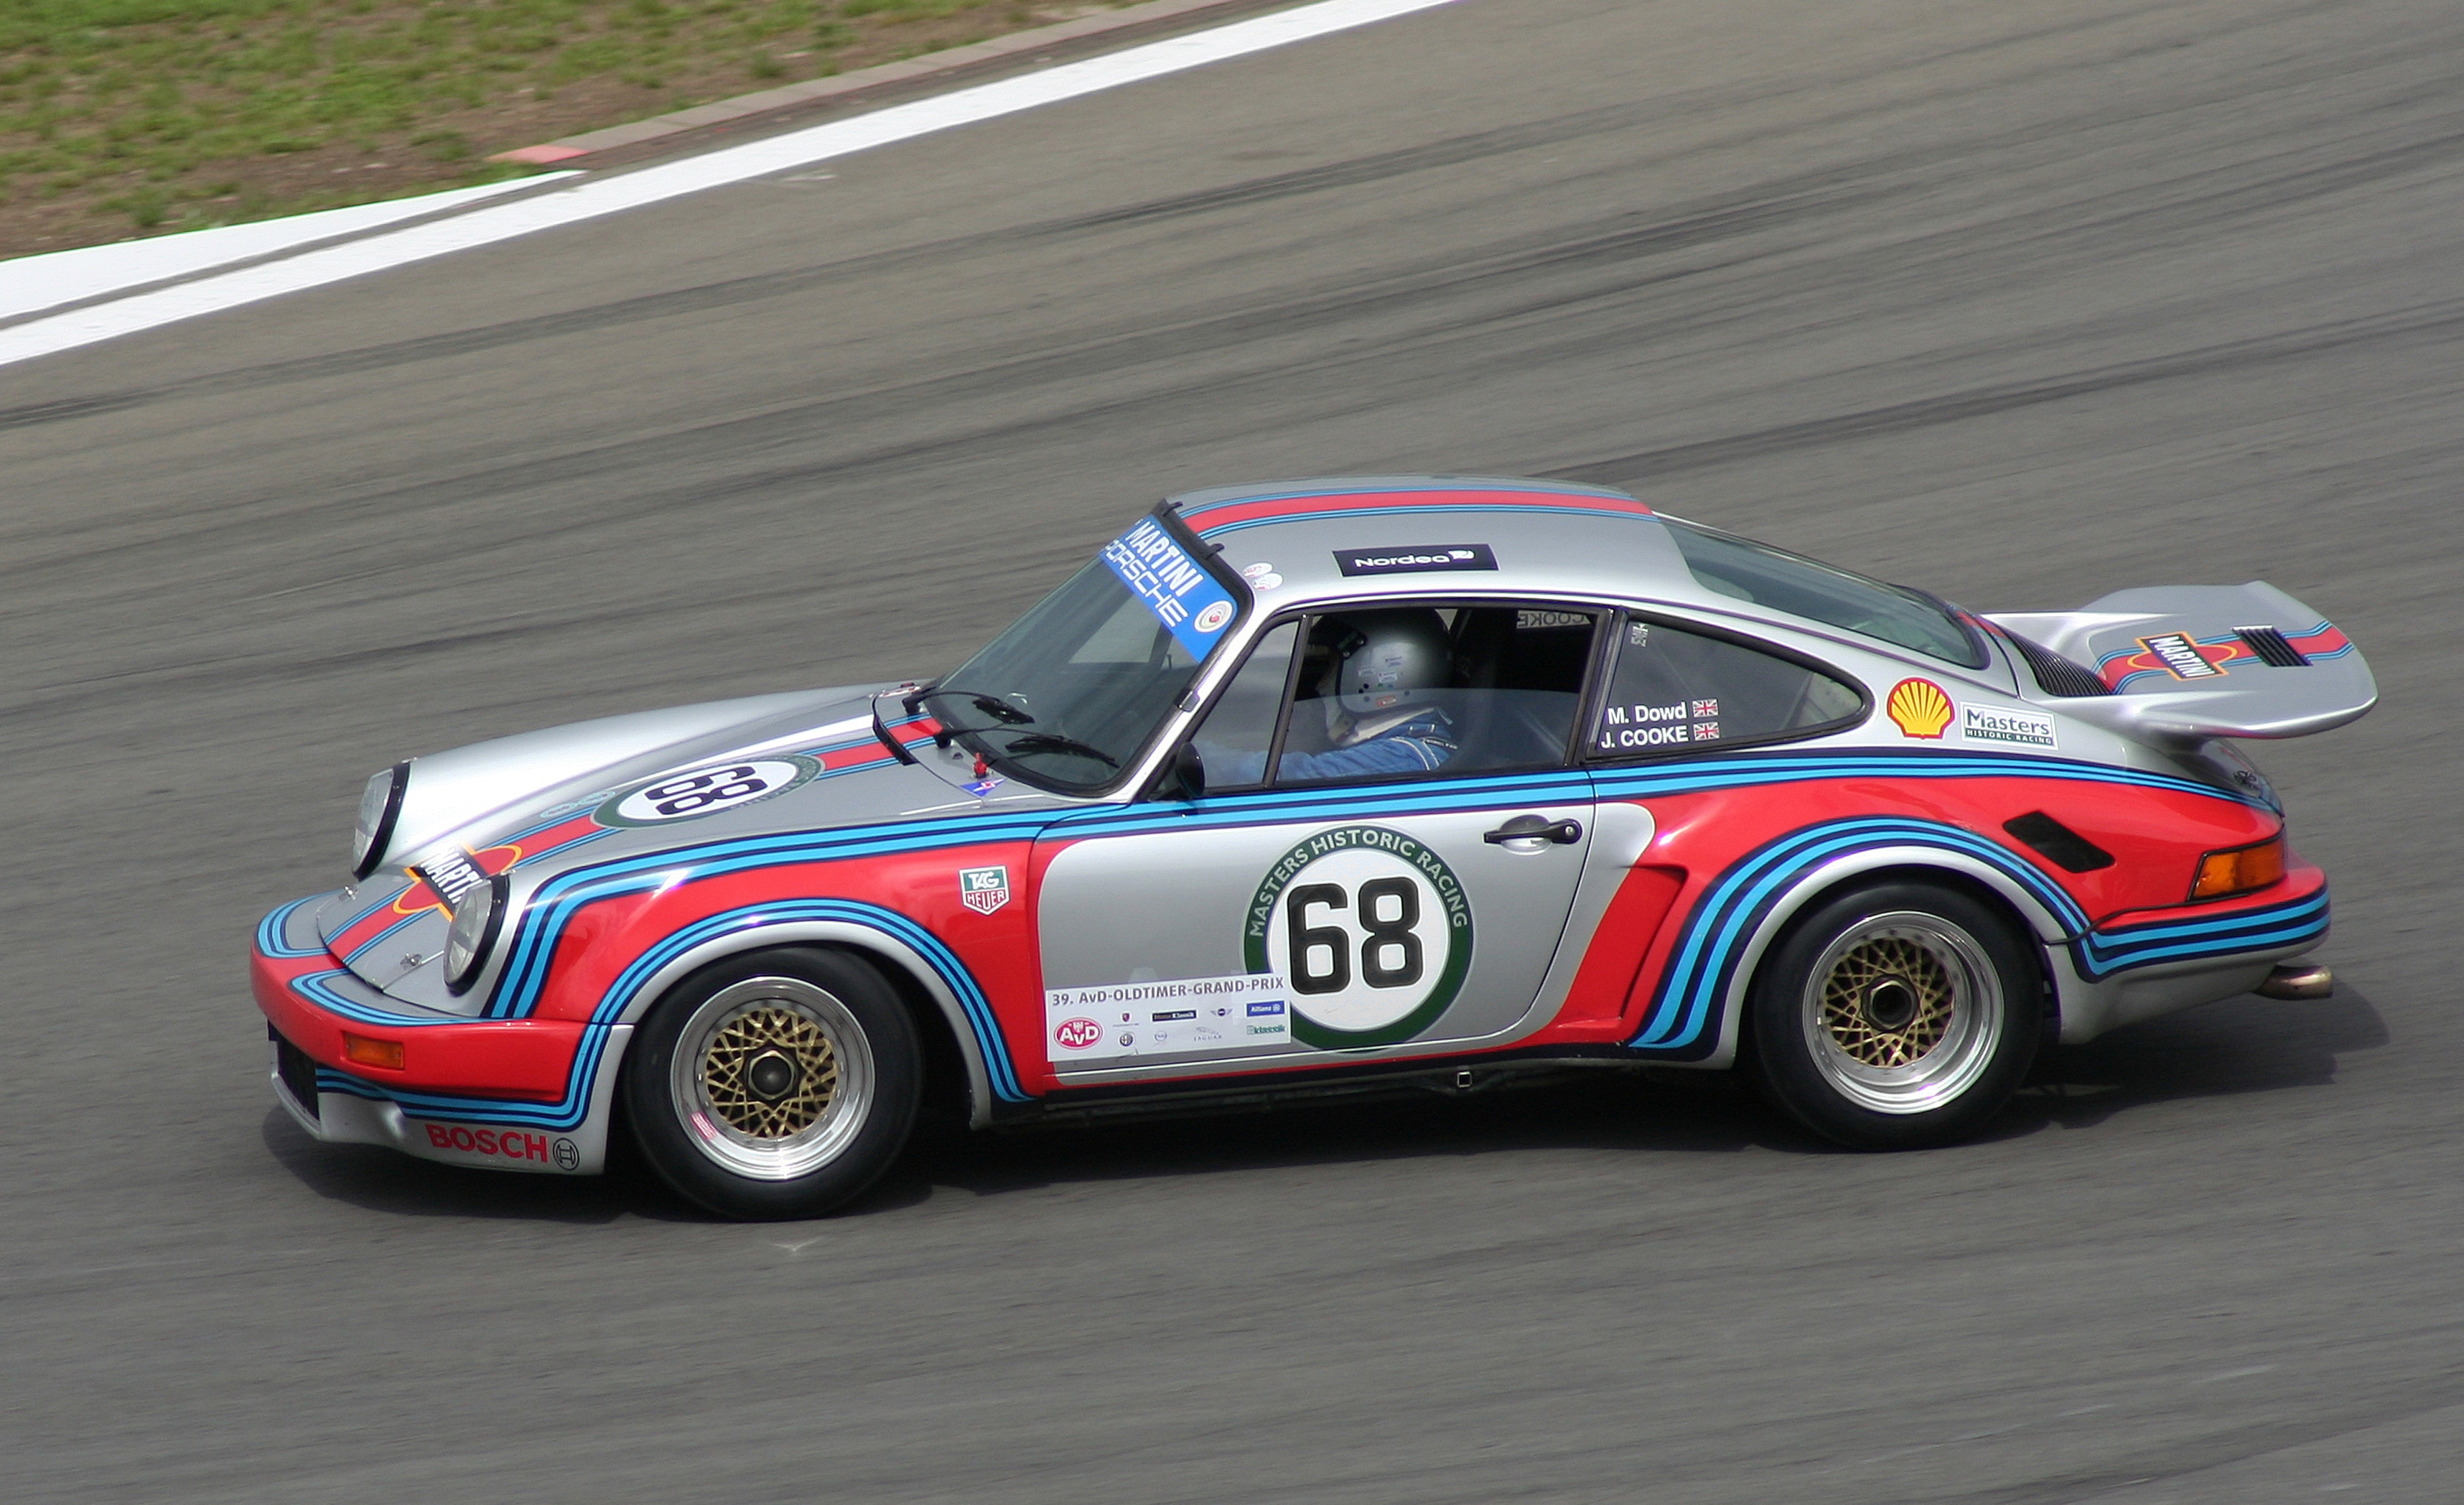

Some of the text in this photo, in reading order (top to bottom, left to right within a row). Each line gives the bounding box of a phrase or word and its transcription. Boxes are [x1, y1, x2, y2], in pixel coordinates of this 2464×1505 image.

[1125, 521, 1204, 597] MARTINI
[1354, 554, 1450, 567] Nordea
[2149, 635, 2216, 677] MARTINI
[1607, 702, 1687, 725] M. Dowd
[1966, 709, 2050, 735] Masters
[1600, 725, 1689, 748] J. COOKE
[1967, 730, 2052, 745] HISTORIC RACING
[645, 765, 768, 816] 68
[420, 847, 483, 904] MARTI
[968, 871, 999, 890] TAG
[1249, 829, 1467, 937] MASTERS HISTORIC RACING
[967, 890, 1005, 910] HEUER
[1287, 875, 1424, 995] 68
[1053, 977, 1284, 1006] 39. AvD-OLDTIMER-GRAND-PRIX
[425, 1124, 549, 1163] BOSCH
